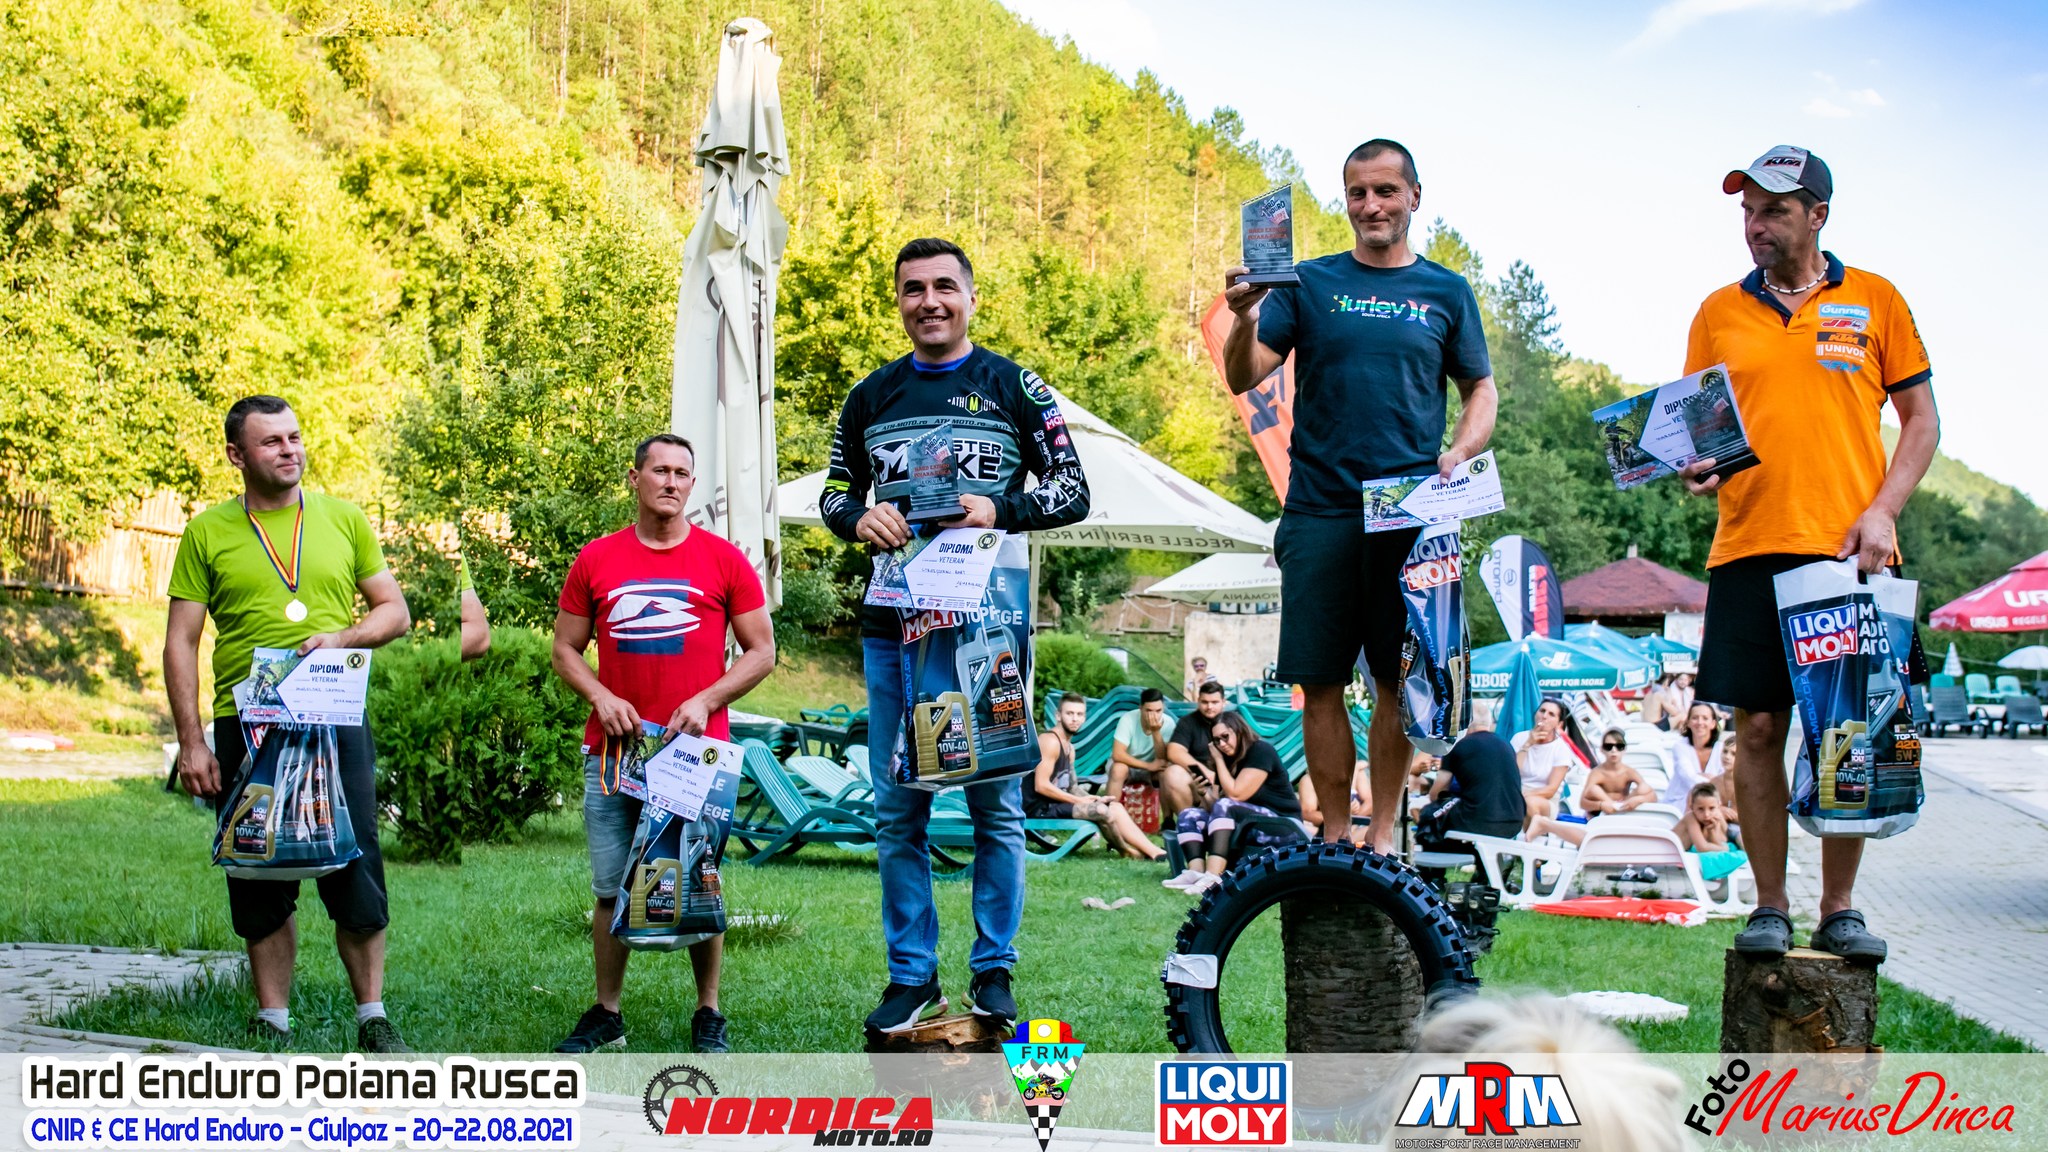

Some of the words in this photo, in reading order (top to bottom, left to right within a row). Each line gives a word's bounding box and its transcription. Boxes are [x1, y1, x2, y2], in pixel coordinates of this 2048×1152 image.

[1330, 295, 1406, 318] Hurley
[1821, 305, 1867, 317] Gunnex
[1829, 334, 1859, 345] KTM
[1431, 476, 1470, 490] DIPLOMA
[1436, 487, 1466, 496] VETERAN
[939, 543, 973, 554] DIPLOMA
[940, 556, 965, 564] VETERAN
[905, 609, 950, 641] MOLY
[1793, 606, 1855, 639] LIQUI
[1798, 630, 1855, 662] MOLY
[310, 664, 344, 674] DIPLOMA
[1539, 679, 1562, 687] OPEN
[1581, 678, 1605, 686] MORE
[991, 696, 1006, 704] TOP
[1006, 693, 1022, 701] TEC
[992, 700, 1023, 713] 4200
[994, 709, 1023, 724] 5W-30
[938, 742, 968, 754] 10W-40
[673, 748, 701, 766] DIPLOMA
[672, 762, 692, 773] VETERAN
[1836, 772, 1865, 784] 10W-40
[235, 827, 266, 838] 10W-40
[647, 899, 675, 907] 10W-40
